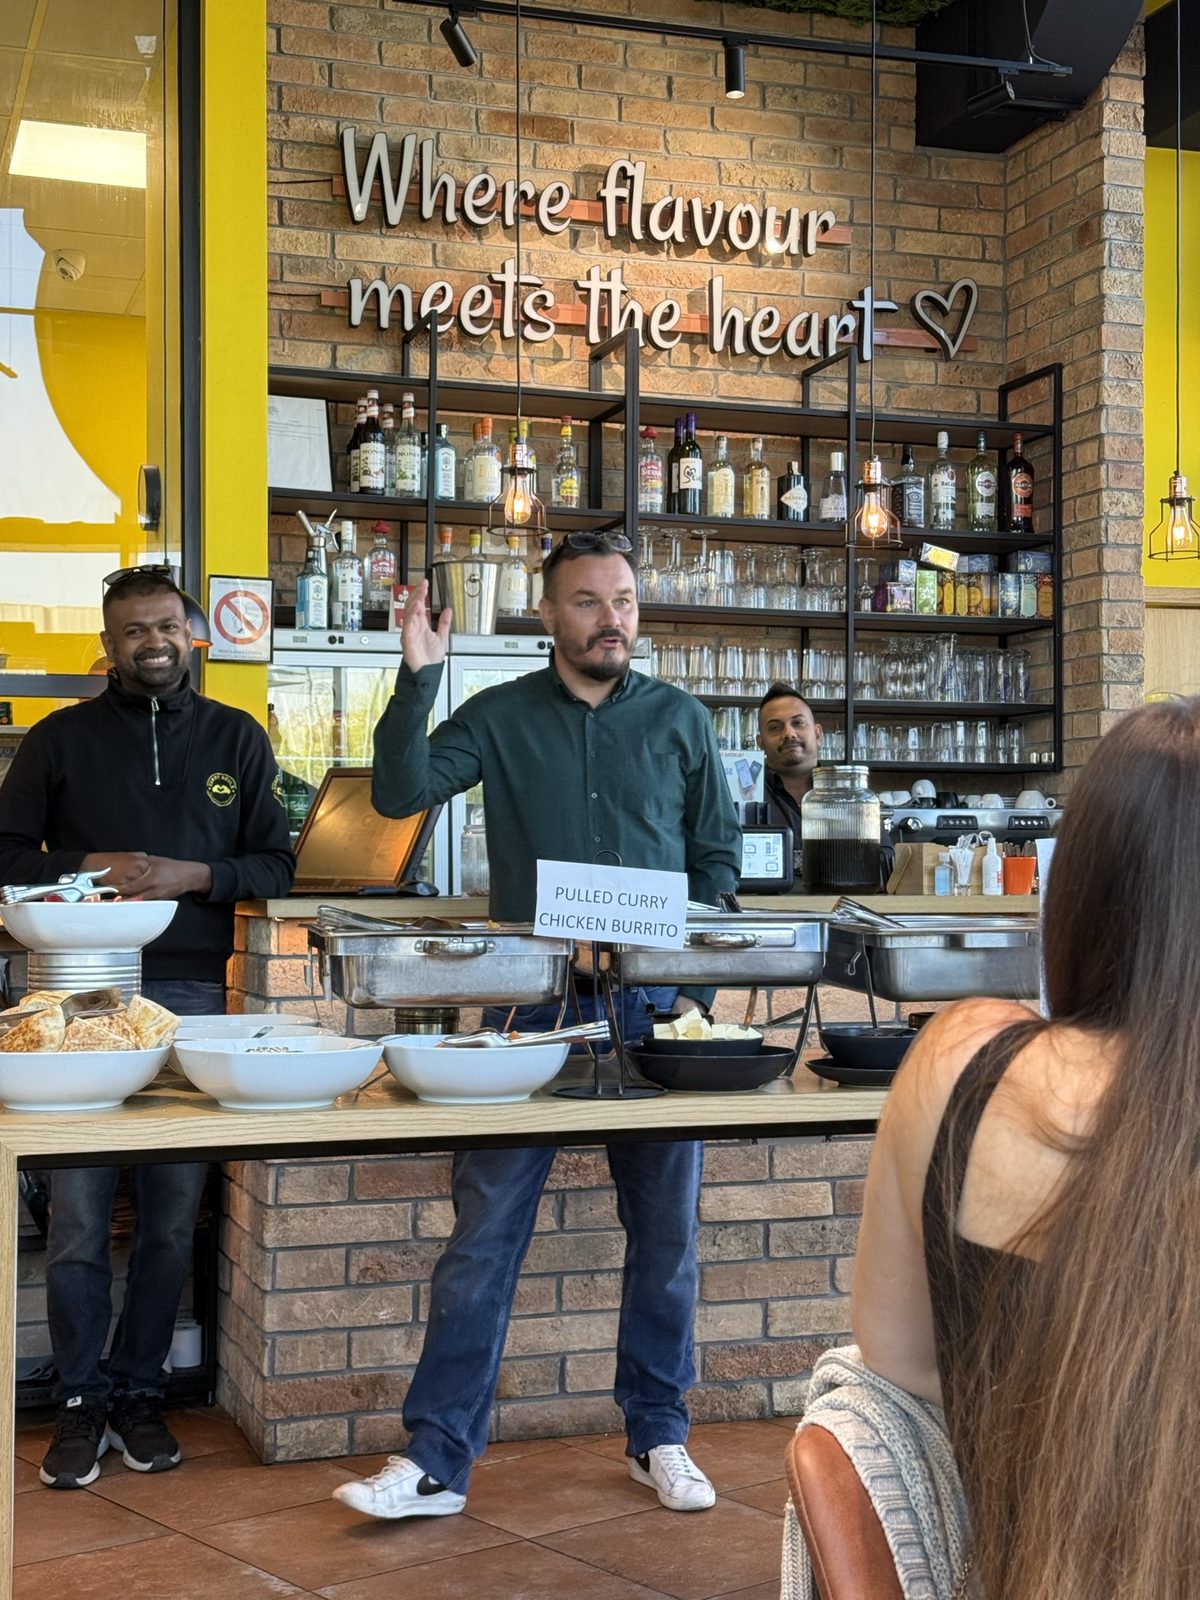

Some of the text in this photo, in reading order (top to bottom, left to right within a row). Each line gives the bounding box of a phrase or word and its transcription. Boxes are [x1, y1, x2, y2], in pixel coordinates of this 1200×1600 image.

[342, 127, 837, 257] Where flavour
[348, 257, 899, 363] meets the heart
[539, 912, 679, 938] CHICKEN BURRITO
[555, 886, 669, 910] PULLED CURRY
